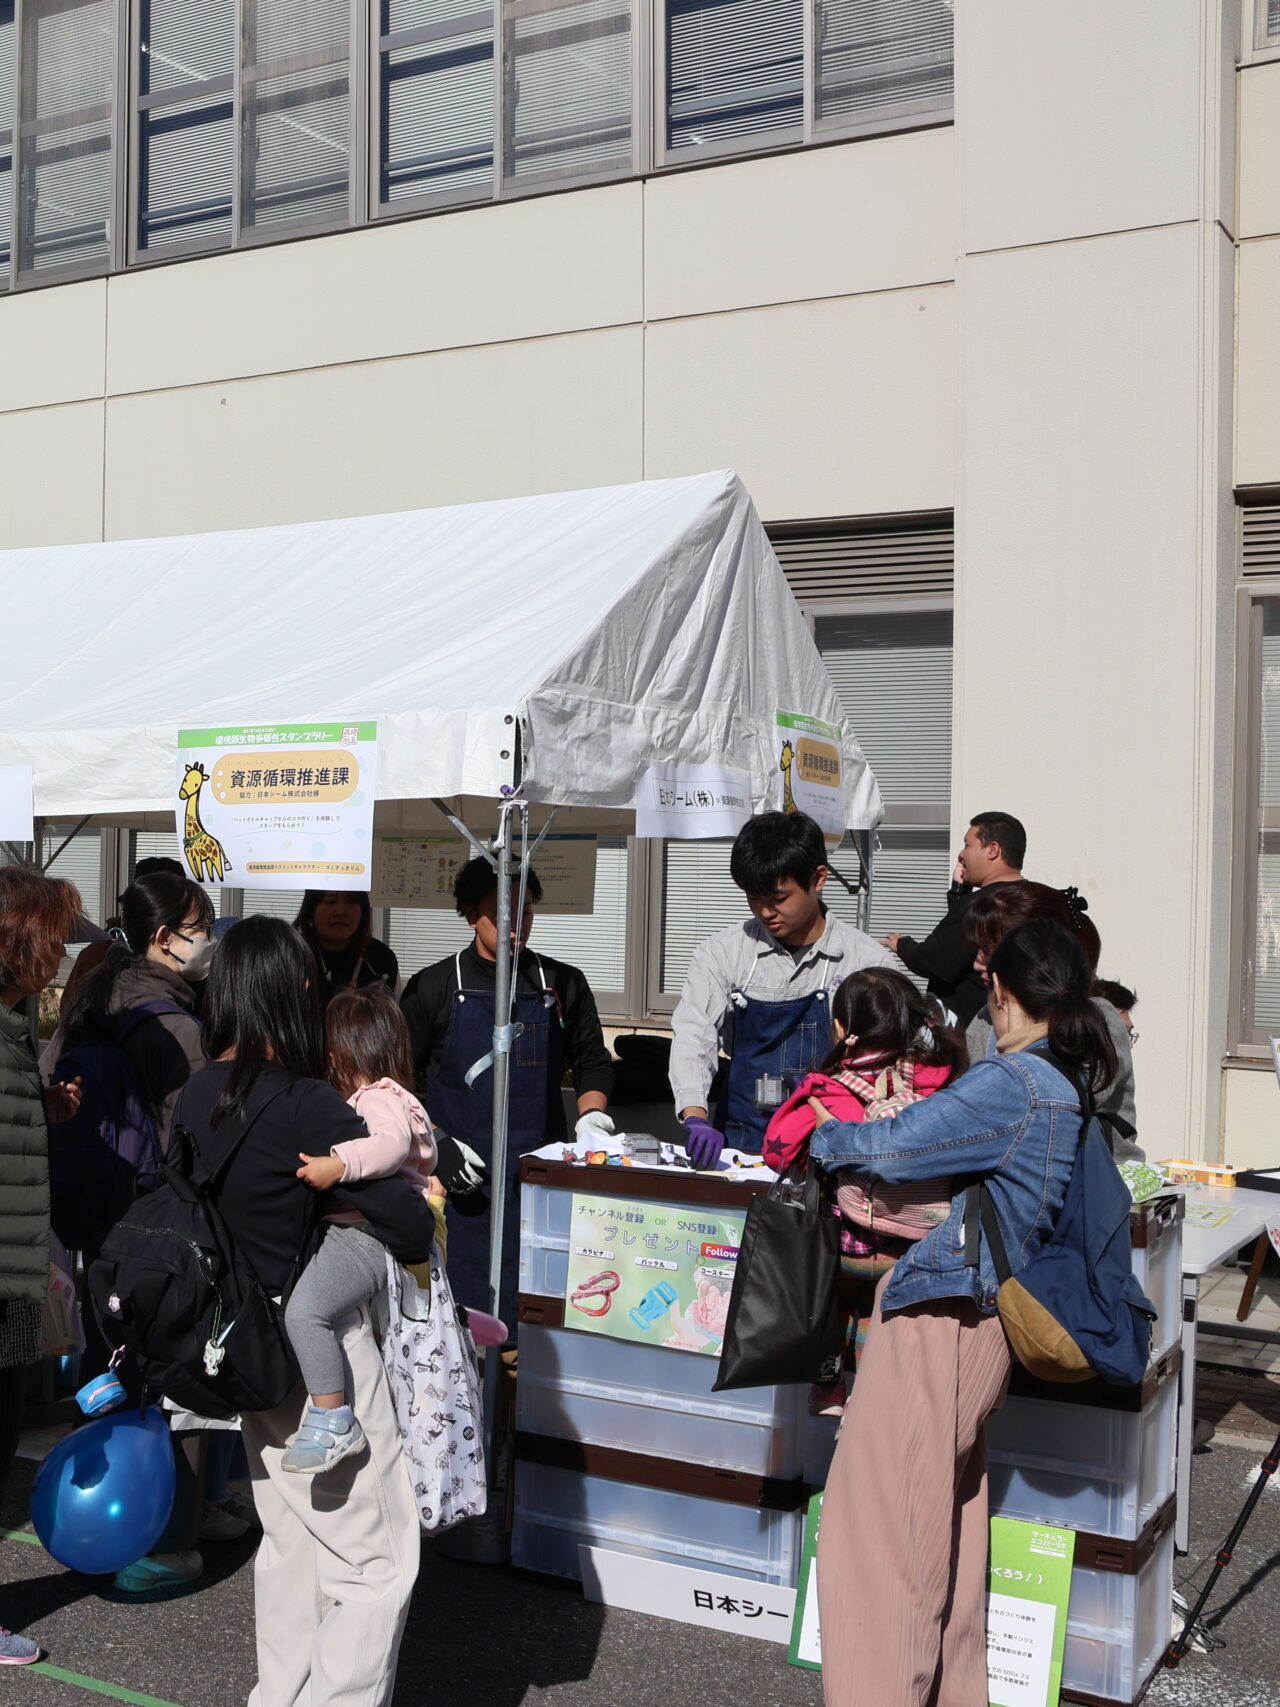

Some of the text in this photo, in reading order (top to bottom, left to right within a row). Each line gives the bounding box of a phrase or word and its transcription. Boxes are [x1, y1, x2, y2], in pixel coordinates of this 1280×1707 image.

[230, 767, 349, 788] 資源循環推進課
[578, 1206, 645, 1224] チャンネル登録
[655, 1218, 667, 1226] OR
[677, 1220, 717, 1235] SNS登録
[604, 1226, 699, 1256] プレゼント
[582, 1248, 604, 1256] カラビナ
[705, 1246, 738, 1258] Follow
[641, 1259, 665, 1268] バックル
[701, 1267, 730, 1276] コースター
[694, 1589, 789, 1618] 日本シー
